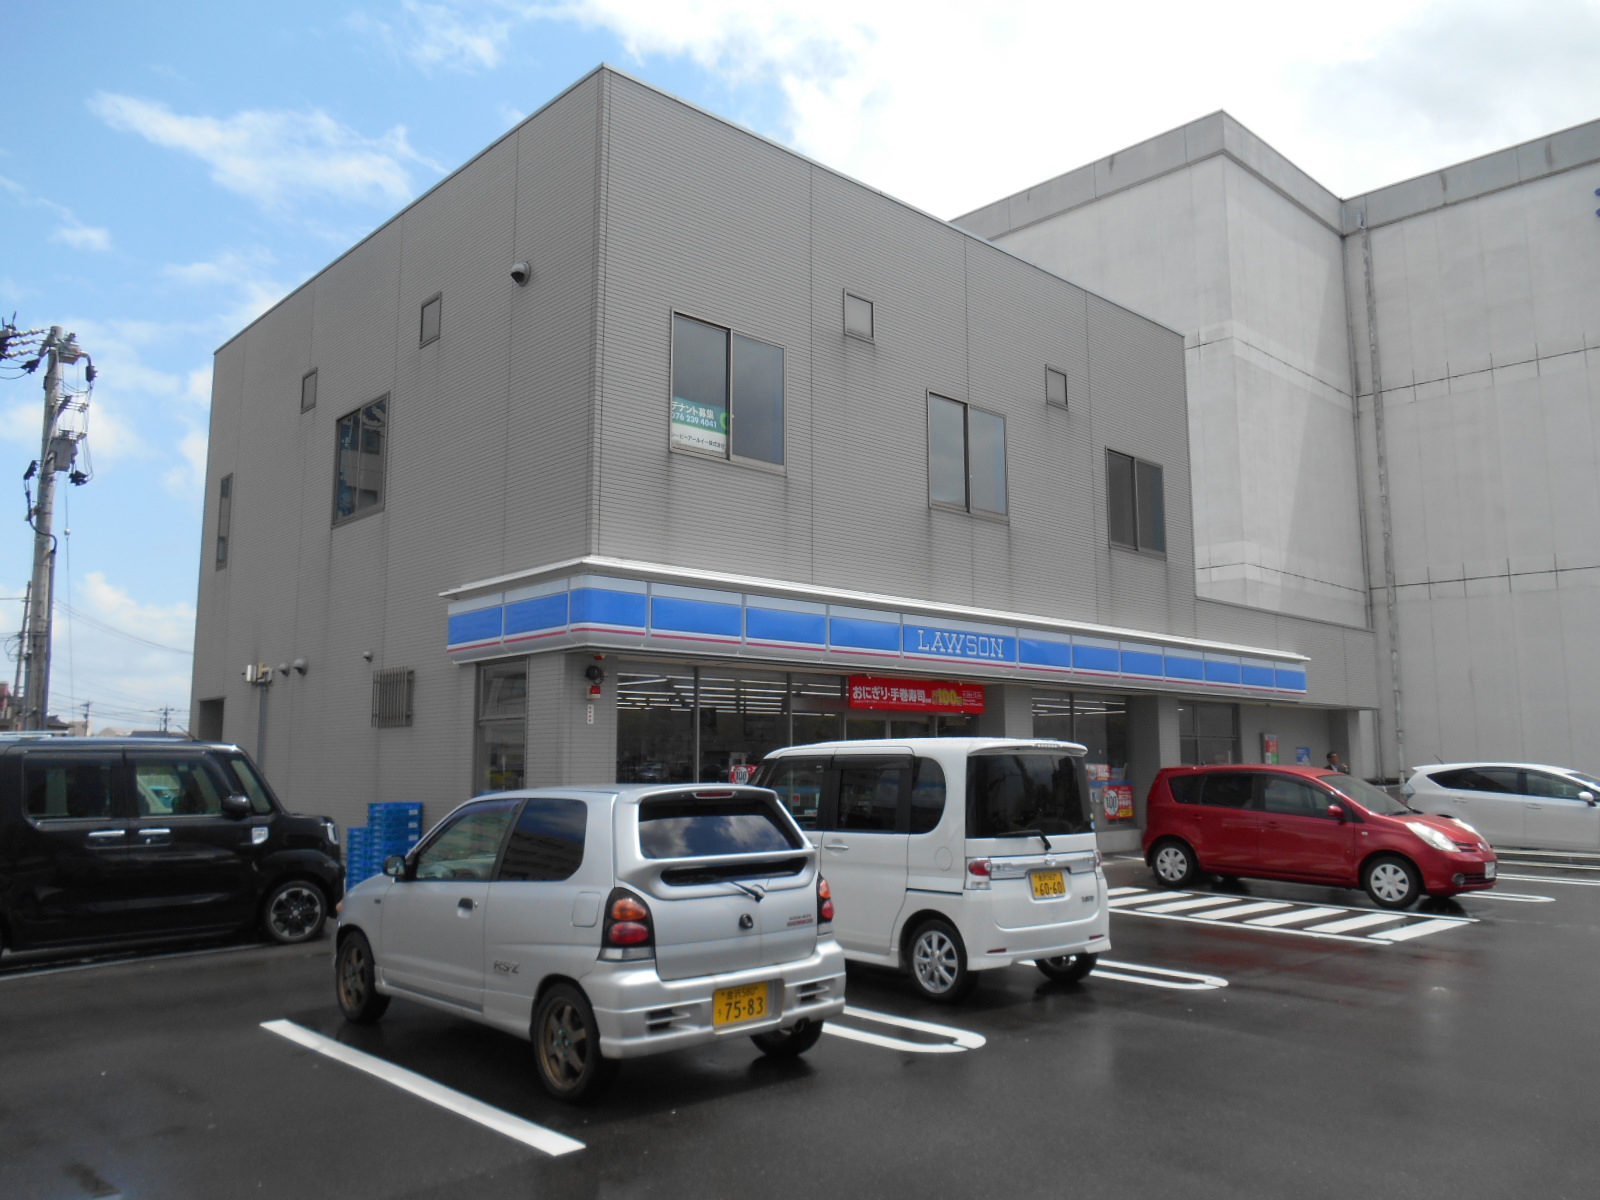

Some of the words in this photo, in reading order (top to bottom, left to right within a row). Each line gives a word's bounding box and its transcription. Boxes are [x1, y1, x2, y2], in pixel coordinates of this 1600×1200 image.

[686, 414, 699, 424] 239
[700, 418, 717, 428] 4041
[918, 629, 1004, 658] LAWSON
[725, 997, 763, 1020] 75-83
